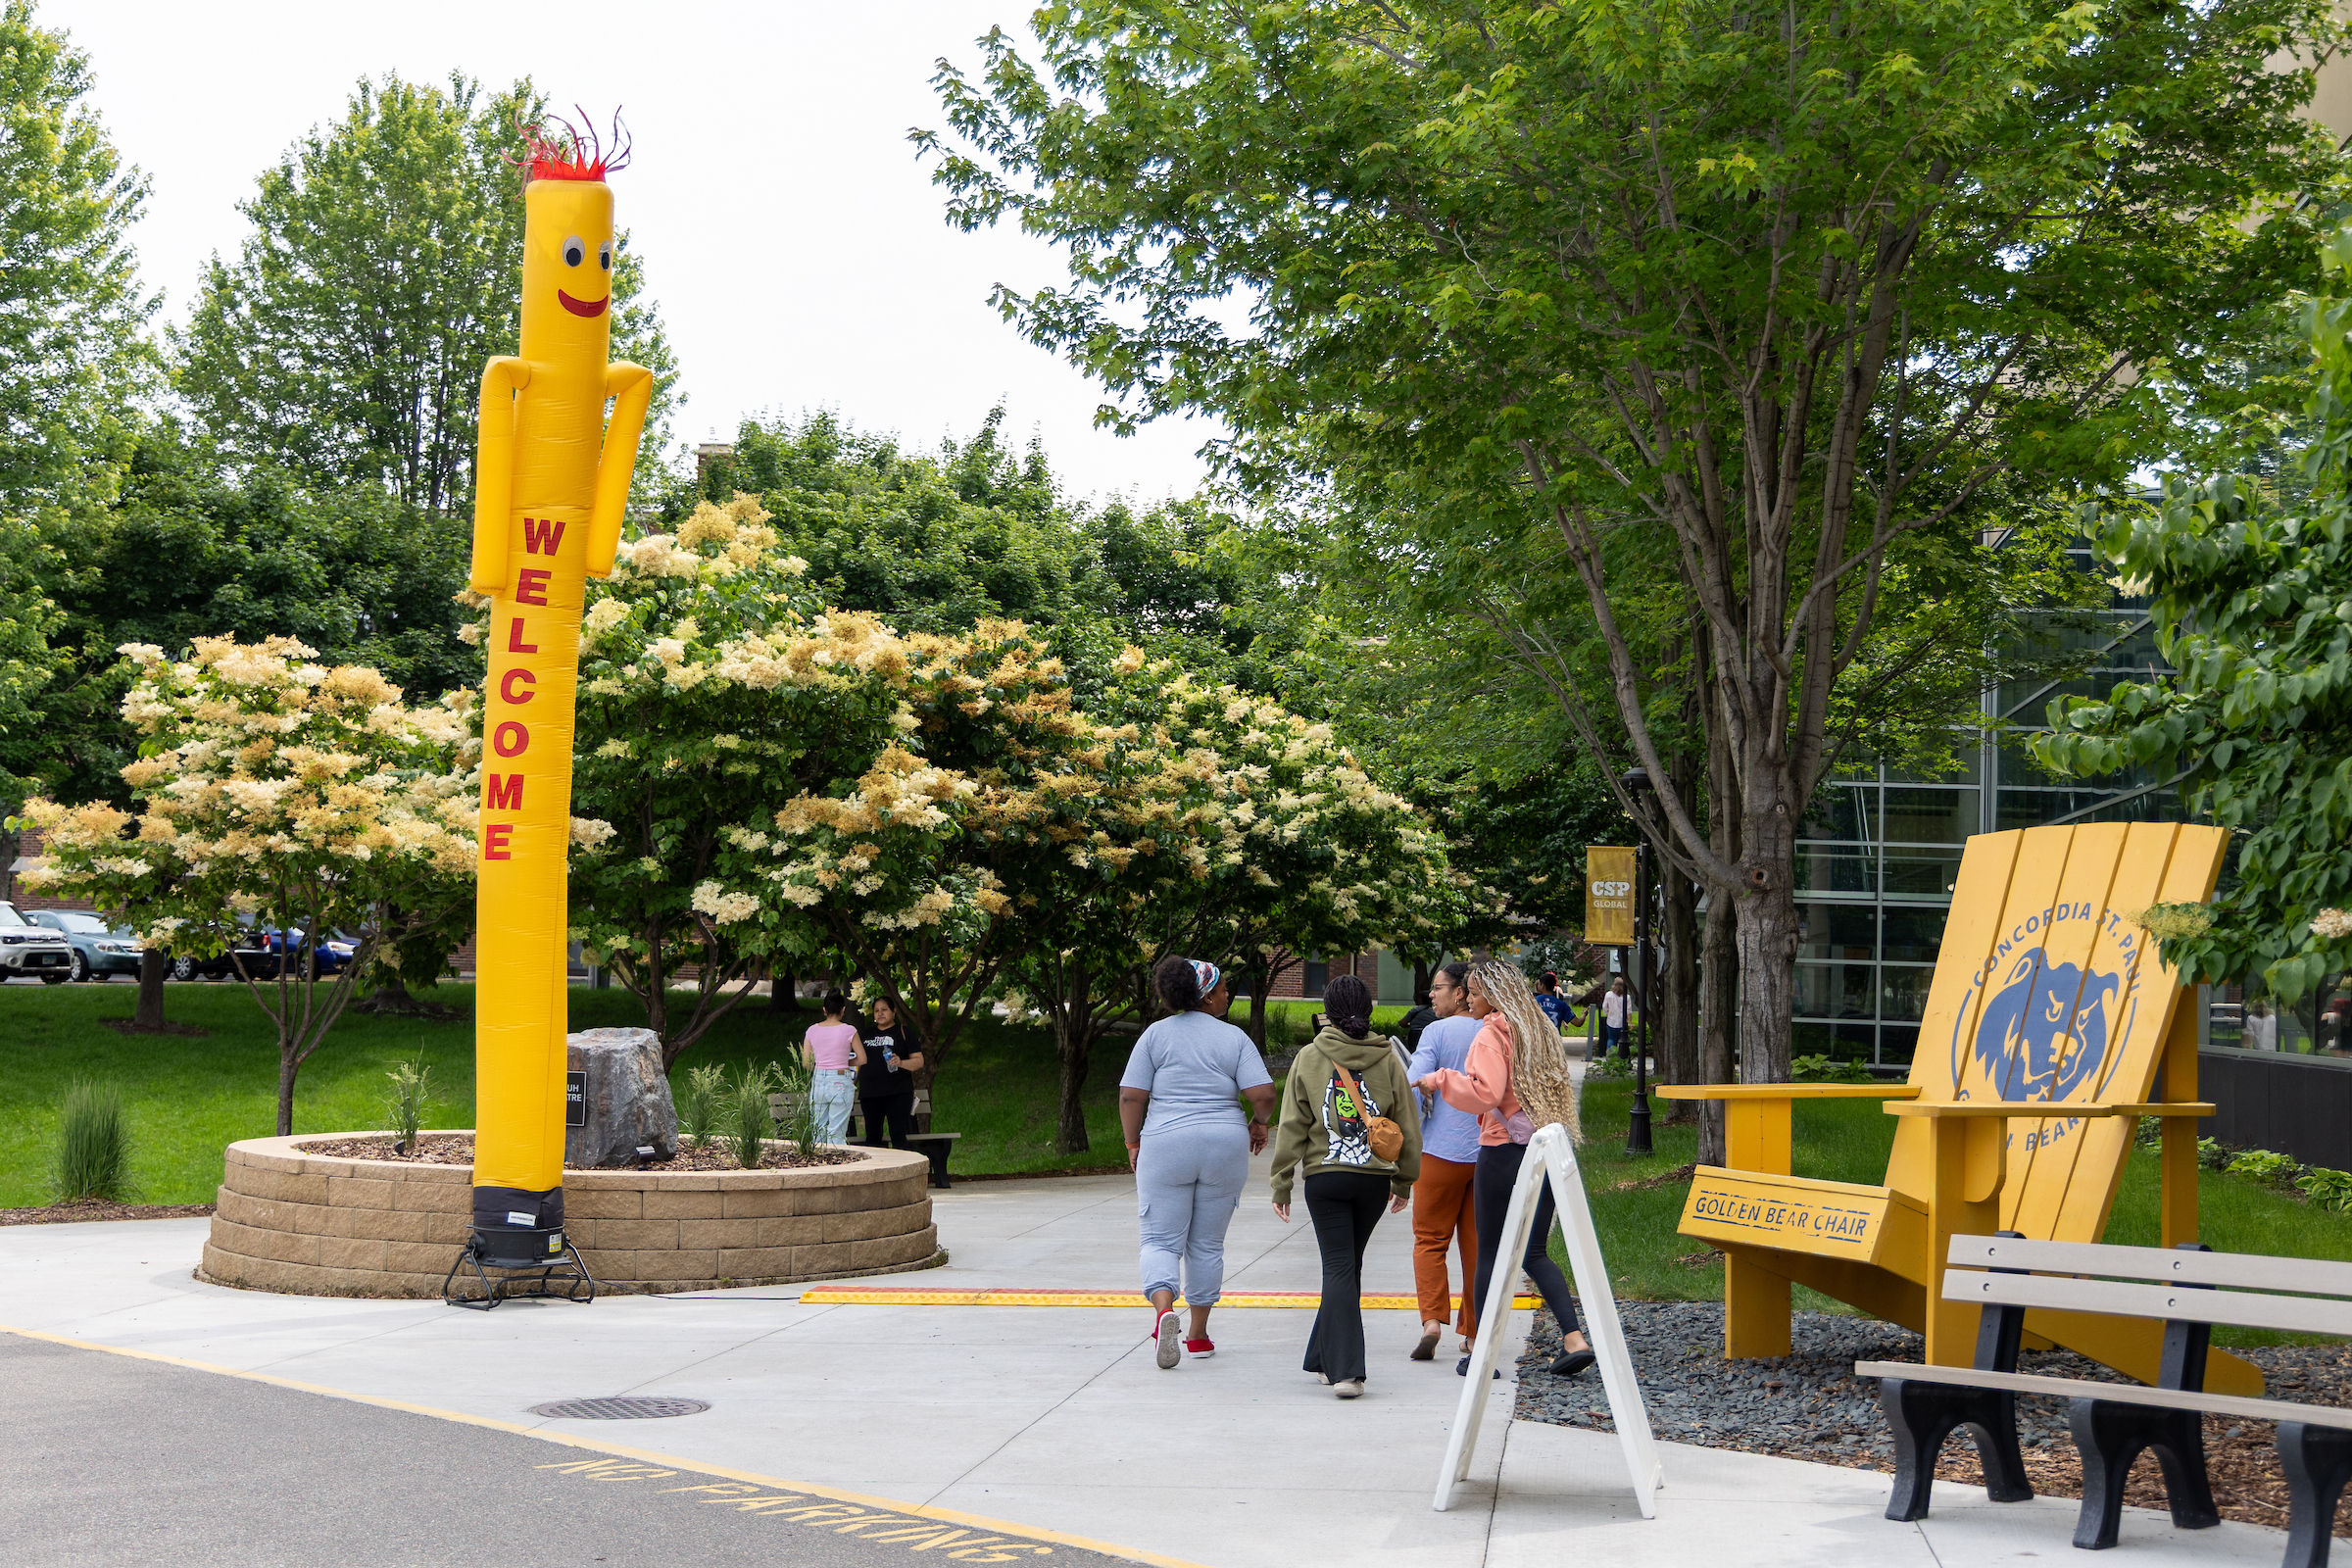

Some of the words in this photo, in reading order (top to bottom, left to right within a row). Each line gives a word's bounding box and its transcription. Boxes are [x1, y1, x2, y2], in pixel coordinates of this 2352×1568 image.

[485, 517, 565, 860] WELCOME
[1592, 881, 1631, 897] CSP
[1974, 903, 2091, 987] CONCORDIA
[2095, 907, 2121, 937] ST.
[2118, 933, 2140, 999] PAUL
[1695, 1196, 1761, 1221] GOLDEN
[1765, 1206, 1809, 1228] BEAR
[1814, 1214, 1867, 1237] CHAIR
[534, 1458, 677, 1482] NO
[655, 1483, 1054, 1563] PARKING
